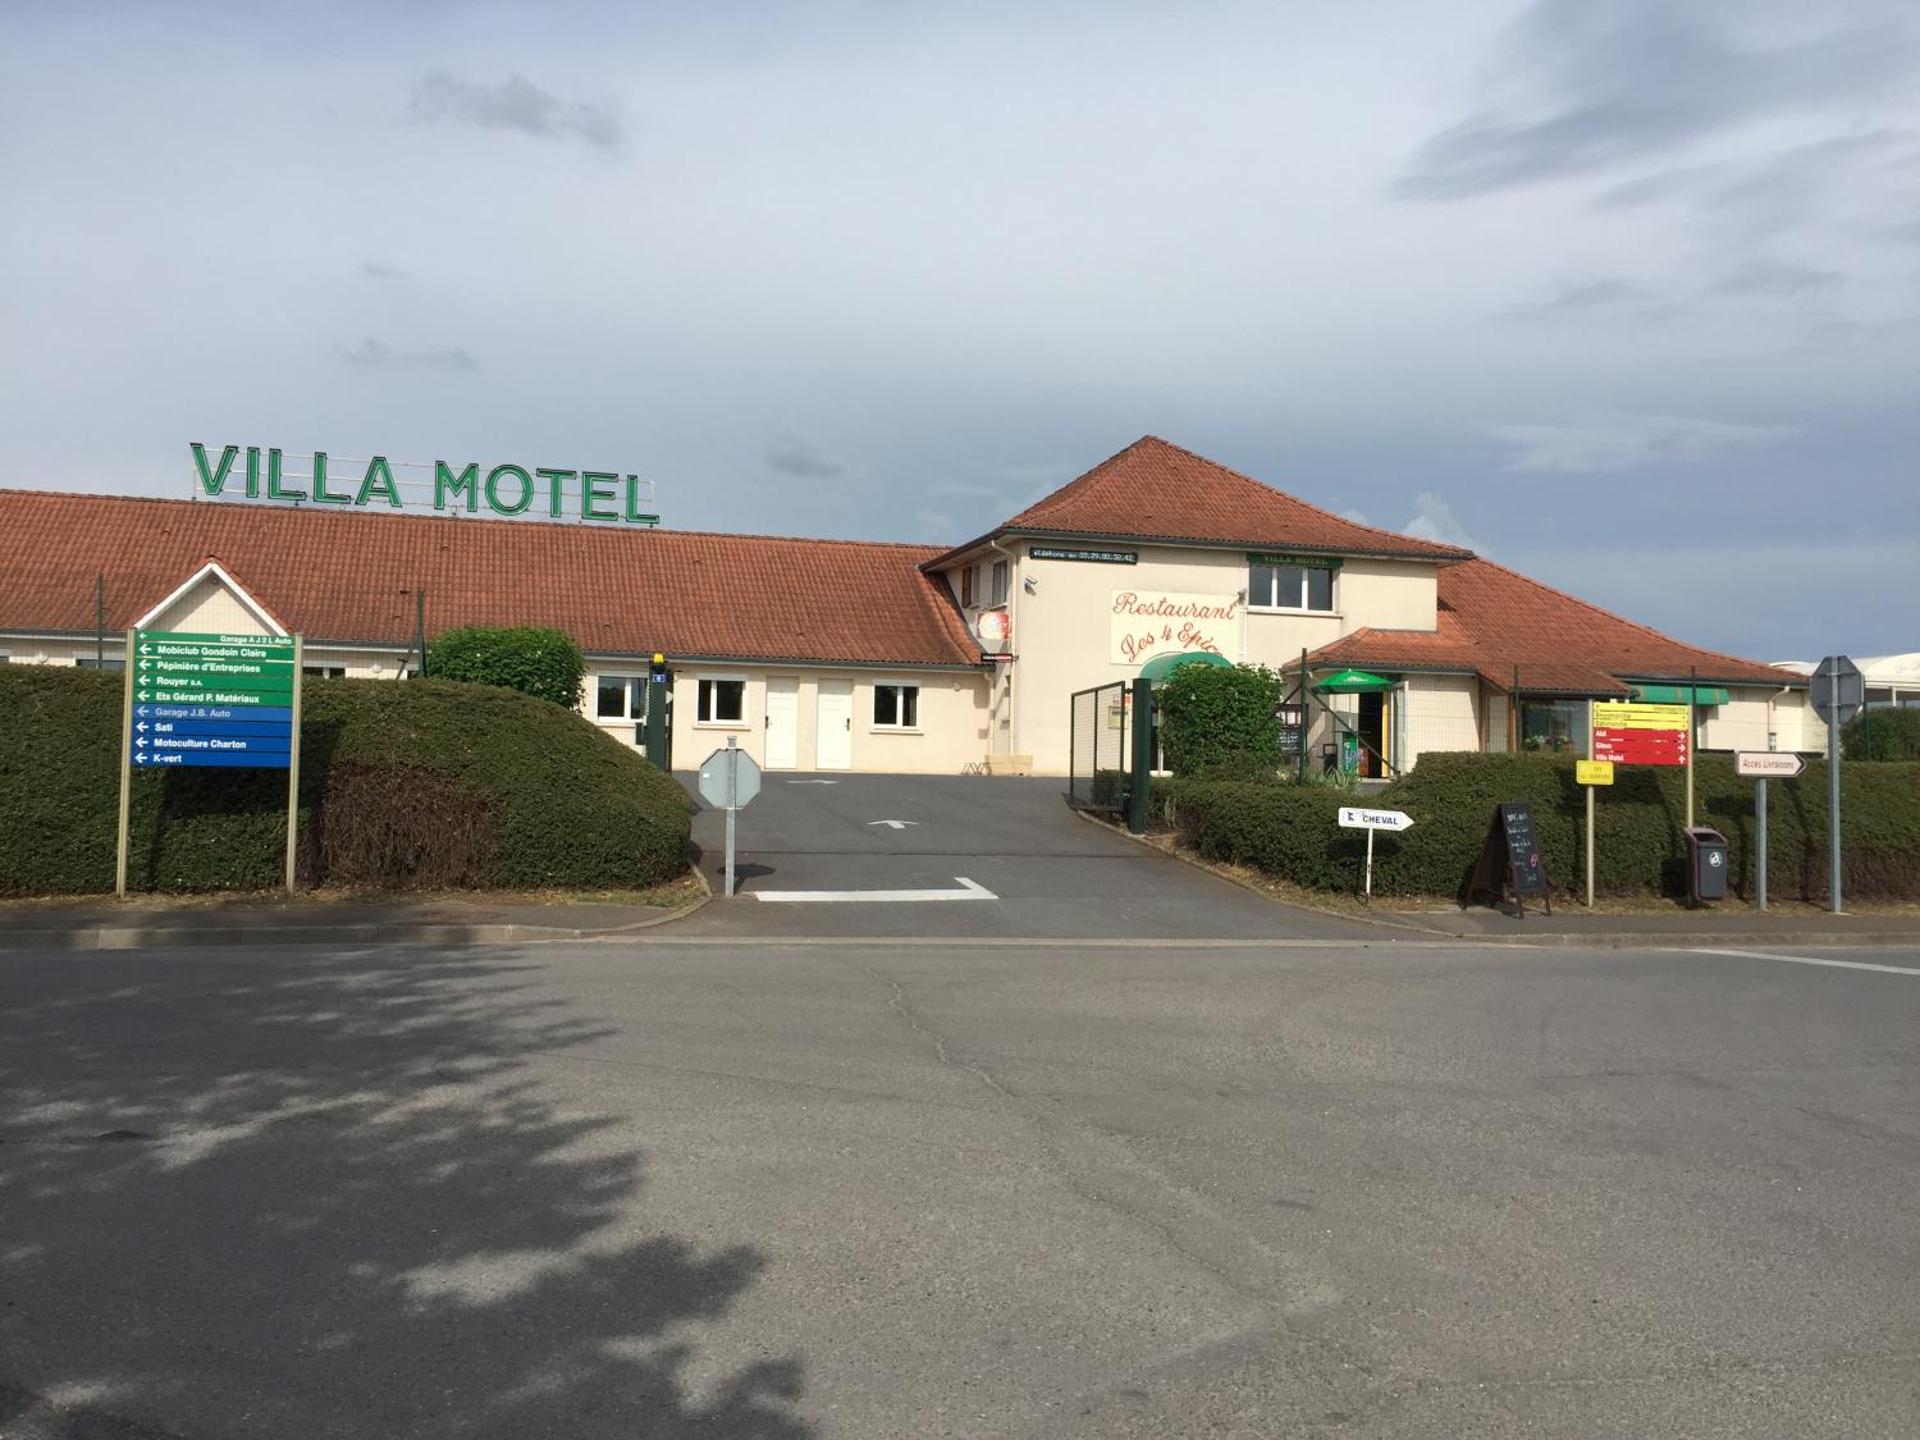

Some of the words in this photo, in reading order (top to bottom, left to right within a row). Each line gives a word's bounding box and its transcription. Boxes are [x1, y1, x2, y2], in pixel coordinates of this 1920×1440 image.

[190, 442, 402, 507] VILLA
[433, 460, 660, 523] MOTEL
[1113, 592, 1239, 620] Restaurant
[220, 635, 248, 645] Garage
[275, 637, 292, 645] Auto
[1120, 632, 1155, 663] Les
[1161, 624, 1172, 641] 4
[157, 645, 199, 655] Mobiclub
[201, 646, 238, 656] Gondoin
[240, 648, 267, 658] Claire
[156, 660, 199, 672] Pépinière
[201, 661, 261, 673] d'Entreprises
[156, 676, 189, 687] Rouyer
[156, 692, 171, 701] Ets
[173, 692, 204, 702] Gérard
[206, 693, 214, 702] P.
[215, 693, 260, 703] Matériaux
[155, 708, 188, 718] Garage
[190, 709, 206, 717] J.B.
[209, 709, 231, 717] Auto
[154, 723, 173, 732] Sati
[153, 738, 209, 749] Motoculture
[210, 739, 247, 749] Charton
[153, 753, 182, 763] K-vert
[1362, 815, 1399, 825] CHEVAL
